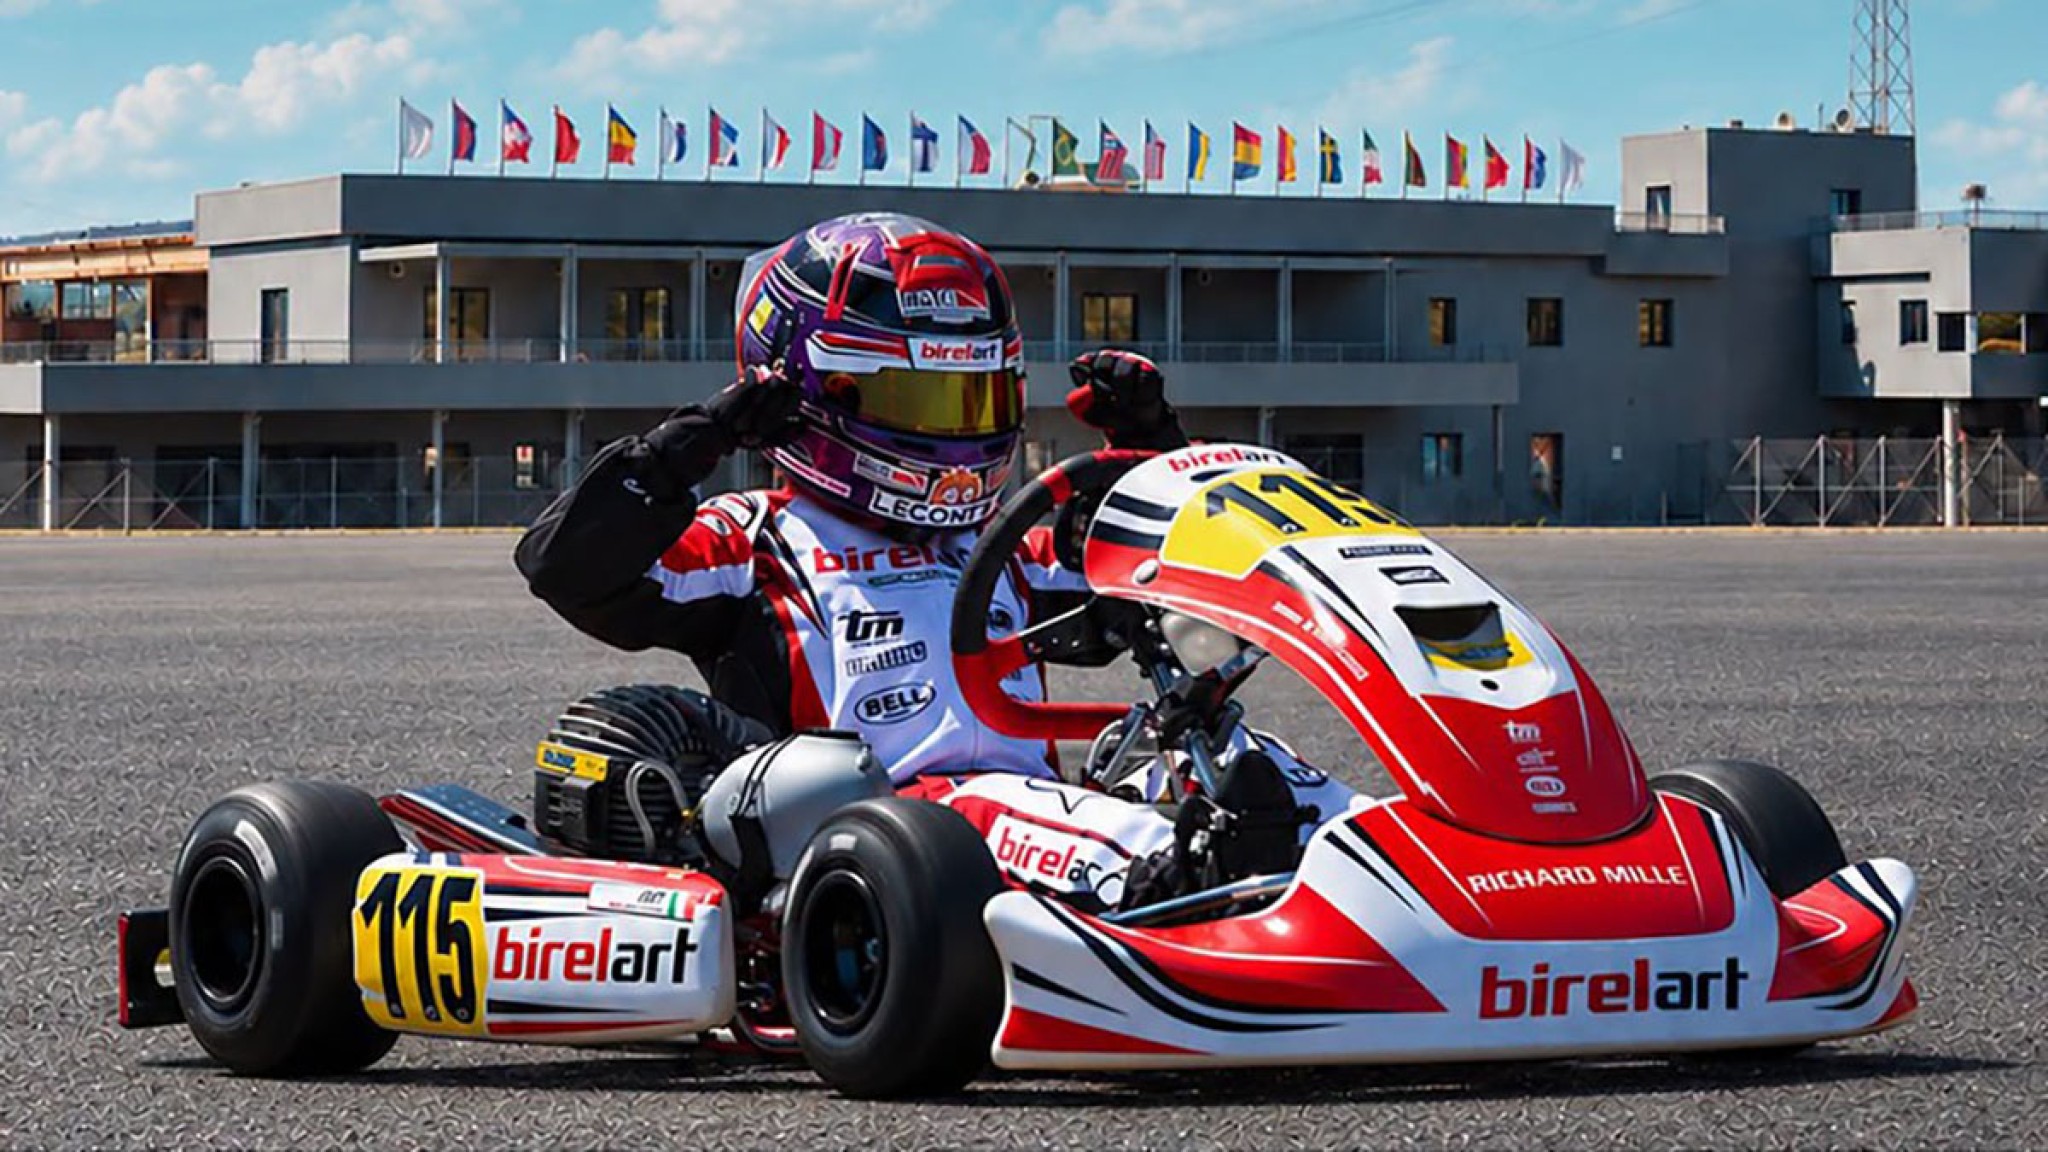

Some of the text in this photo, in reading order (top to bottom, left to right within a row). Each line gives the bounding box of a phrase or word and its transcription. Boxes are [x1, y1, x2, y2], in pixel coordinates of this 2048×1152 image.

[864, 687, 928, 718] BELL
[1468, 865, 1687, 894] RICHARD MILLE
[363, 871, 476, 1023] 115
[494, 926, 698, 984] birelart
[1479, 956, 1749, 1020] birelart
